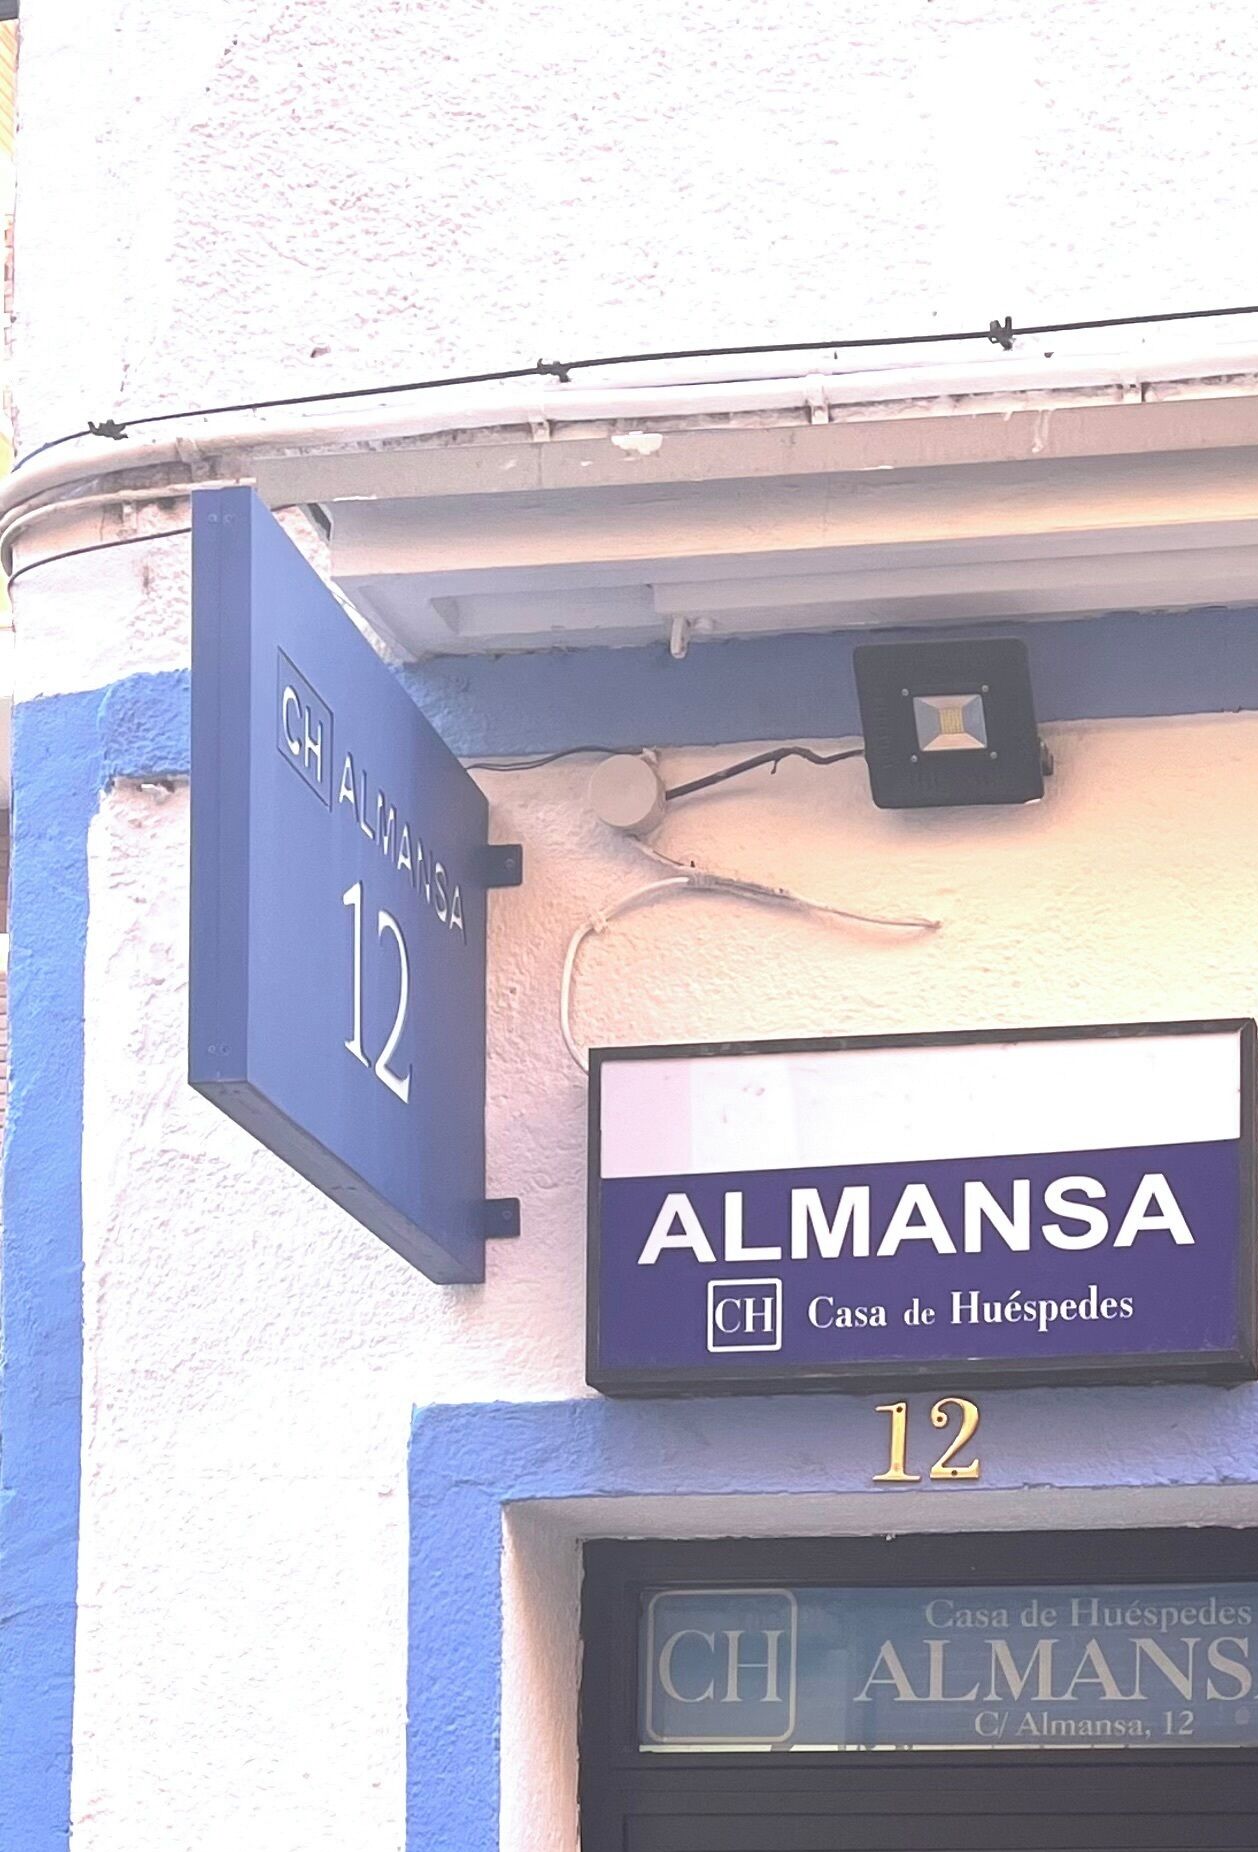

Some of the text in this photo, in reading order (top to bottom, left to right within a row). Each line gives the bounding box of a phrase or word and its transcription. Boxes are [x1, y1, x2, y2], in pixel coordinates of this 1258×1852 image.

[282, 686, 467, 944] CH ALMANSA
[342, 881, 413, 1104] 12
[637, 1173, 1195, 1265] ALMANSA
[714, 1285, 1134, 1334] CH Casa de Huéspedes
[873, 1397, 980, 1482] 12
[925, 1597, 1252, 1633] Casa de Huéspedes
[659, 1629, 784, 1703] CH
[975, 1711, 1195, 1738] C/ Almansa, 12
